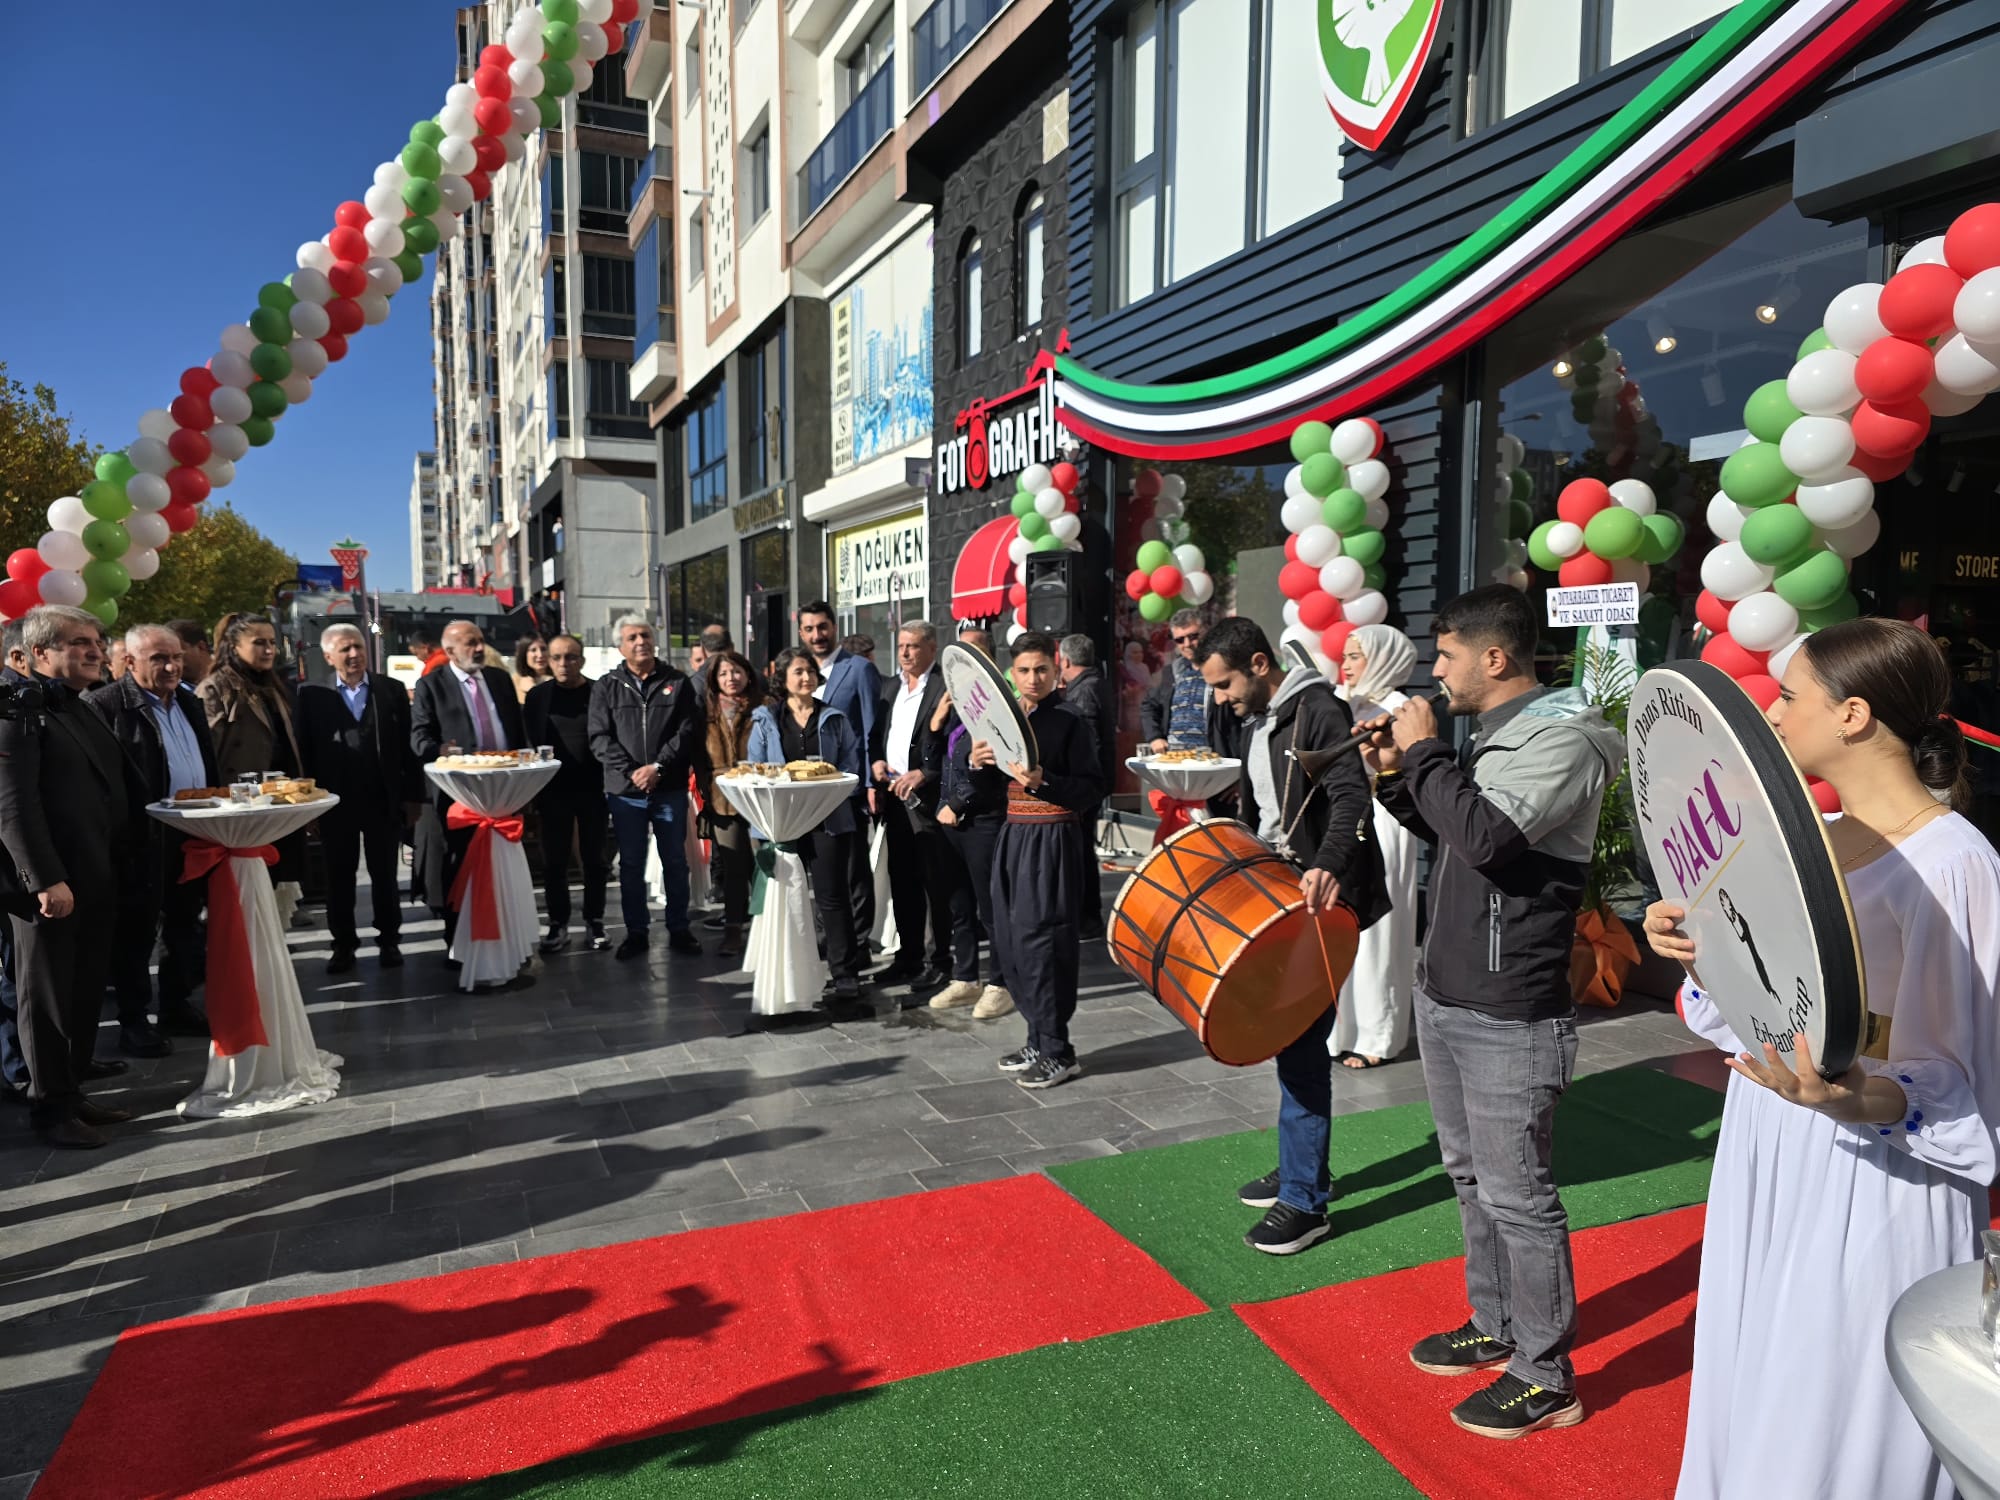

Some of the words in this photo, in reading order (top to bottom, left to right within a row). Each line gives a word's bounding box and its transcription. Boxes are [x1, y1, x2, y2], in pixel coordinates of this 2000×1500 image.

[1955, 554, 2000, 578] STORE
[1559, 610, 1570, 624] VE
[1606, 607, 1635, 622] ODASI
[1634, 698, 1660, 749] Dans
[1655, 687, 1705, 736] Ritim
